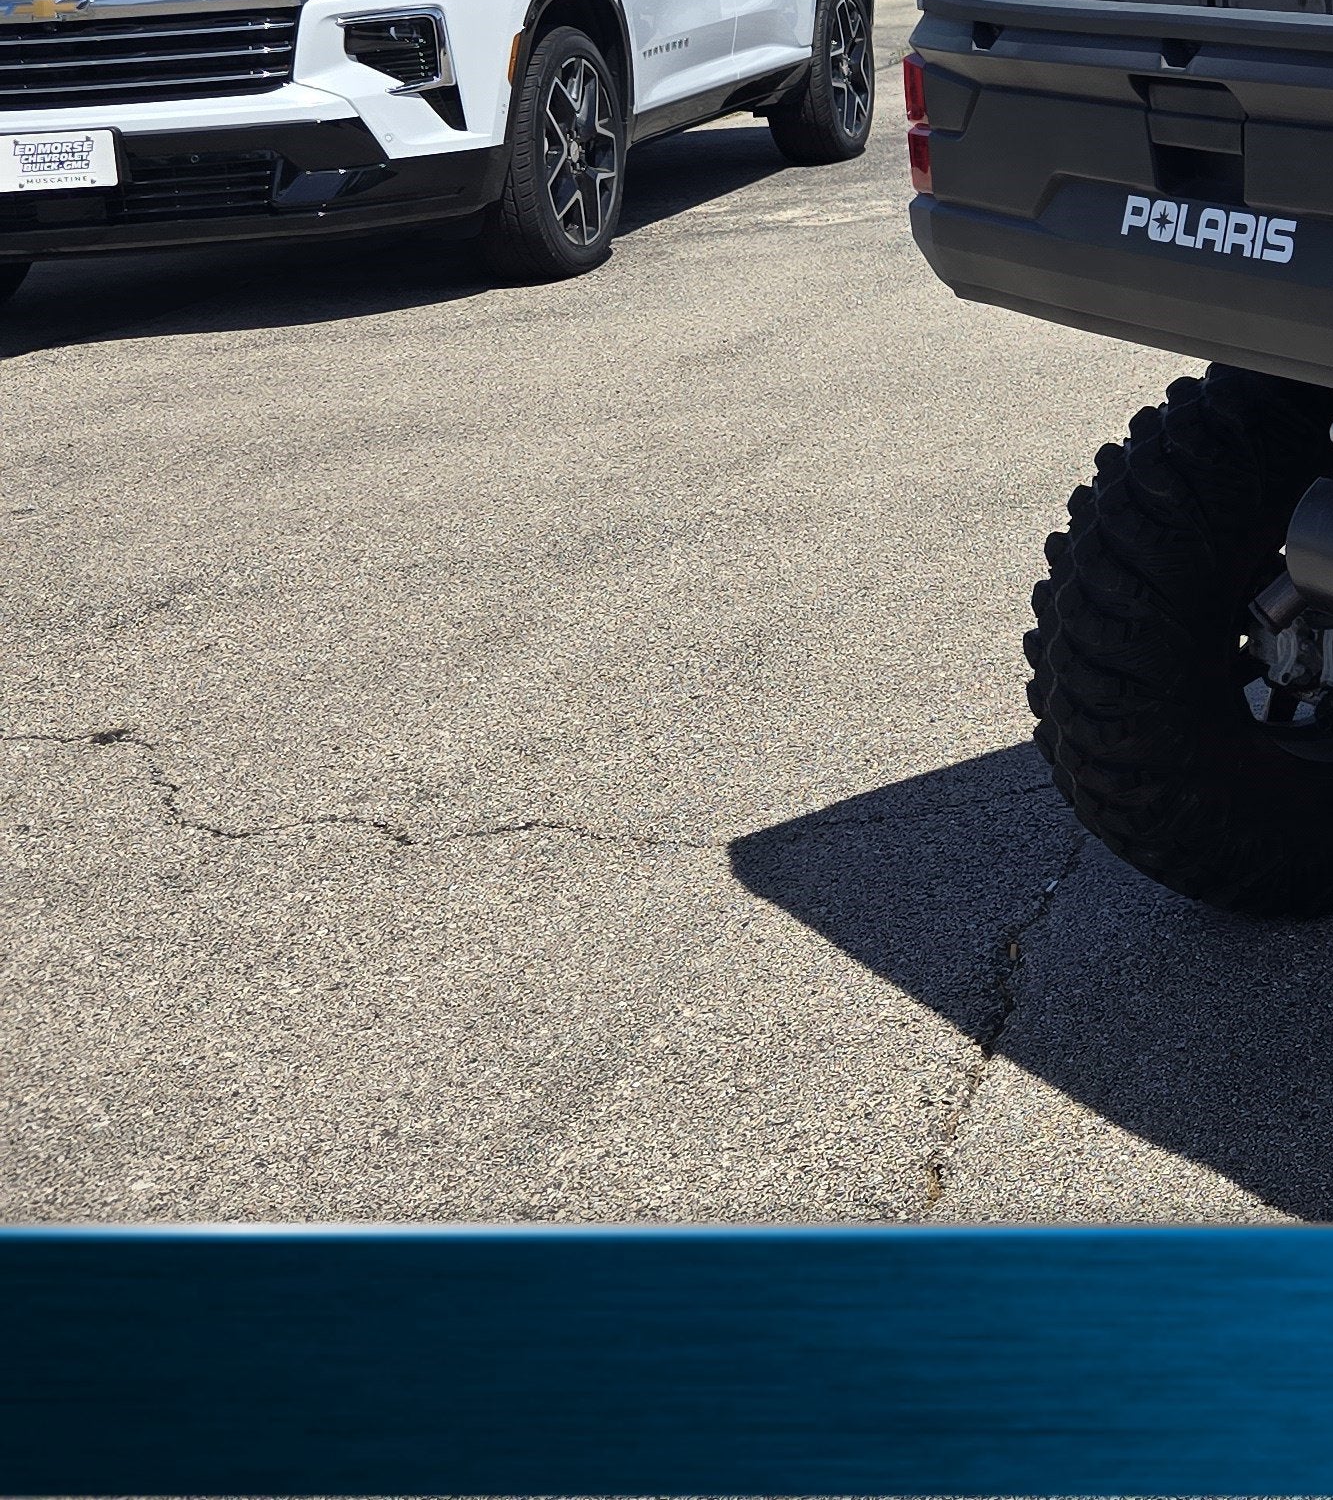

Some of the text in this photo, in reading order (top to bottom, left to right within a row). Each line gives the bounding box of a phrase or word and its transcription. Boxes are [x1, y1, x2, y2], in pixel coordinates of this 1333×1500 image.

[14, 140, 94, 156] ED MORSE
[20, 152, 90, 164] CHEVROLET
[26, 175, 88, 184] MUSCATINE
[1120, 194, 1297, 264] POLARIS
